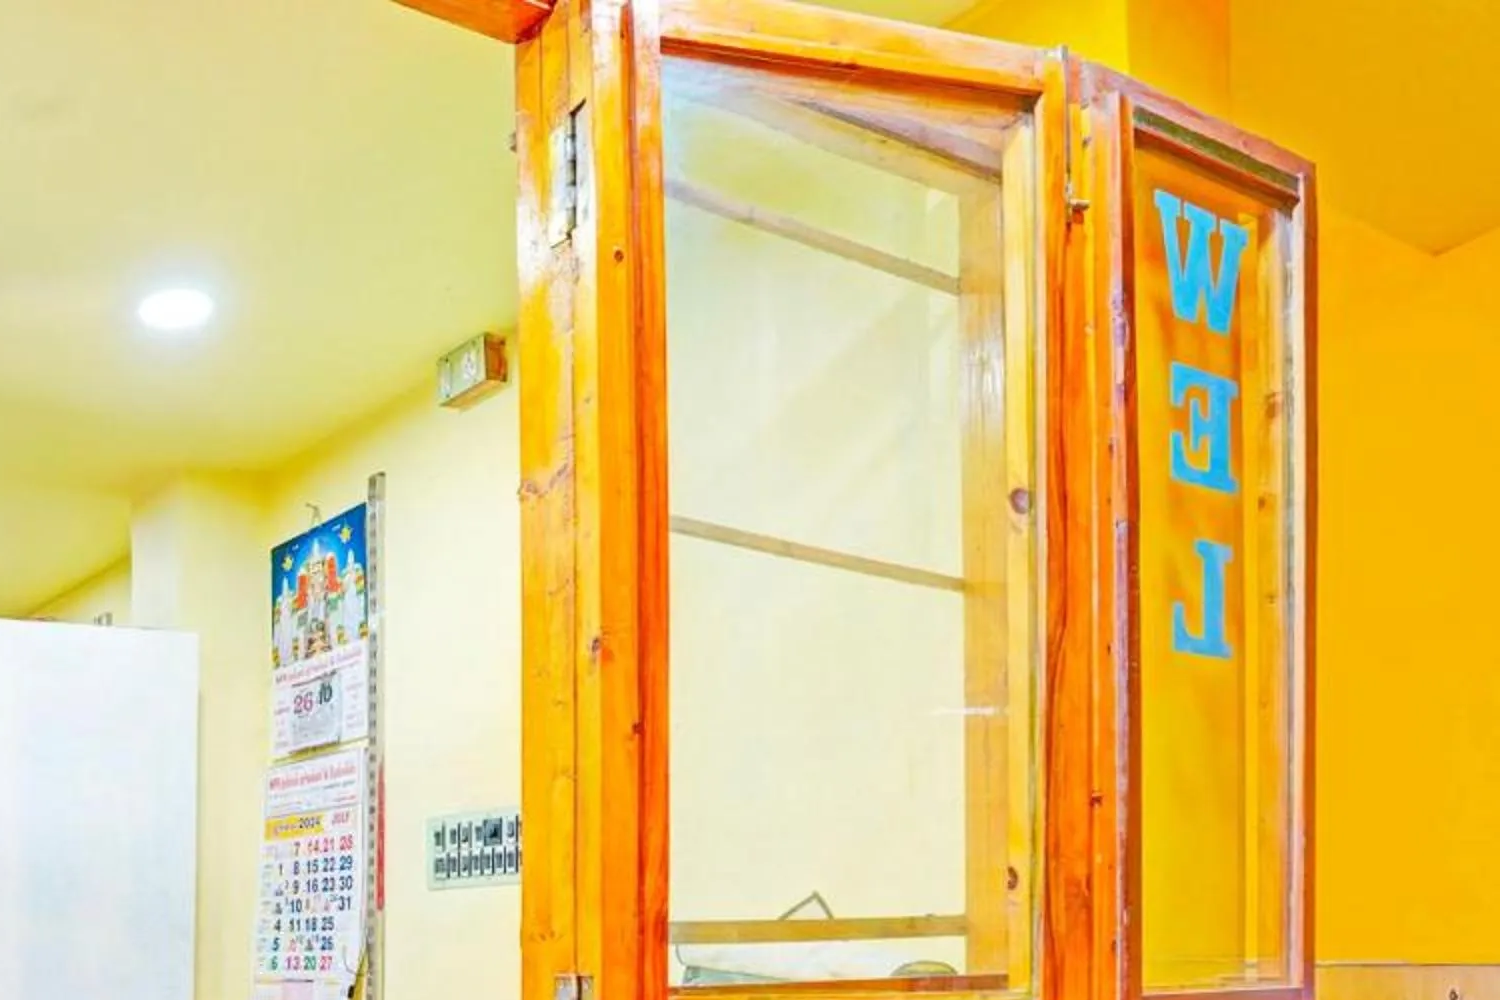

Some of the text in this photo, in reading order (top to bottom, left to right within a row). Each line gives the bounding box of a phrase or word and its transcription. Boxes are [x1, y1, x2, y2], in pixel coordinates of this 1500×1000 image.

[293, 691, 313, 715] 26
[306, 859, 319, 874] 15
[323, 857, 335, 872] 22
[339, 855, 353, 871] 29
[306, 878, 318, 893] 16
[322, 877, 335, 892] 23
[340, 875, 353, 891] 30
[290, 899, 302, 913] 10
[338, 896, 351, 911] 31
[289, 918, 301, 932] 11
[321, 916, 334, 931] 25
[321, 936, 334, 951] 26
[285, 956, 300, 971] 13
[303, 956, 317, 971] 20
[320, 955, 333, 971] 27
